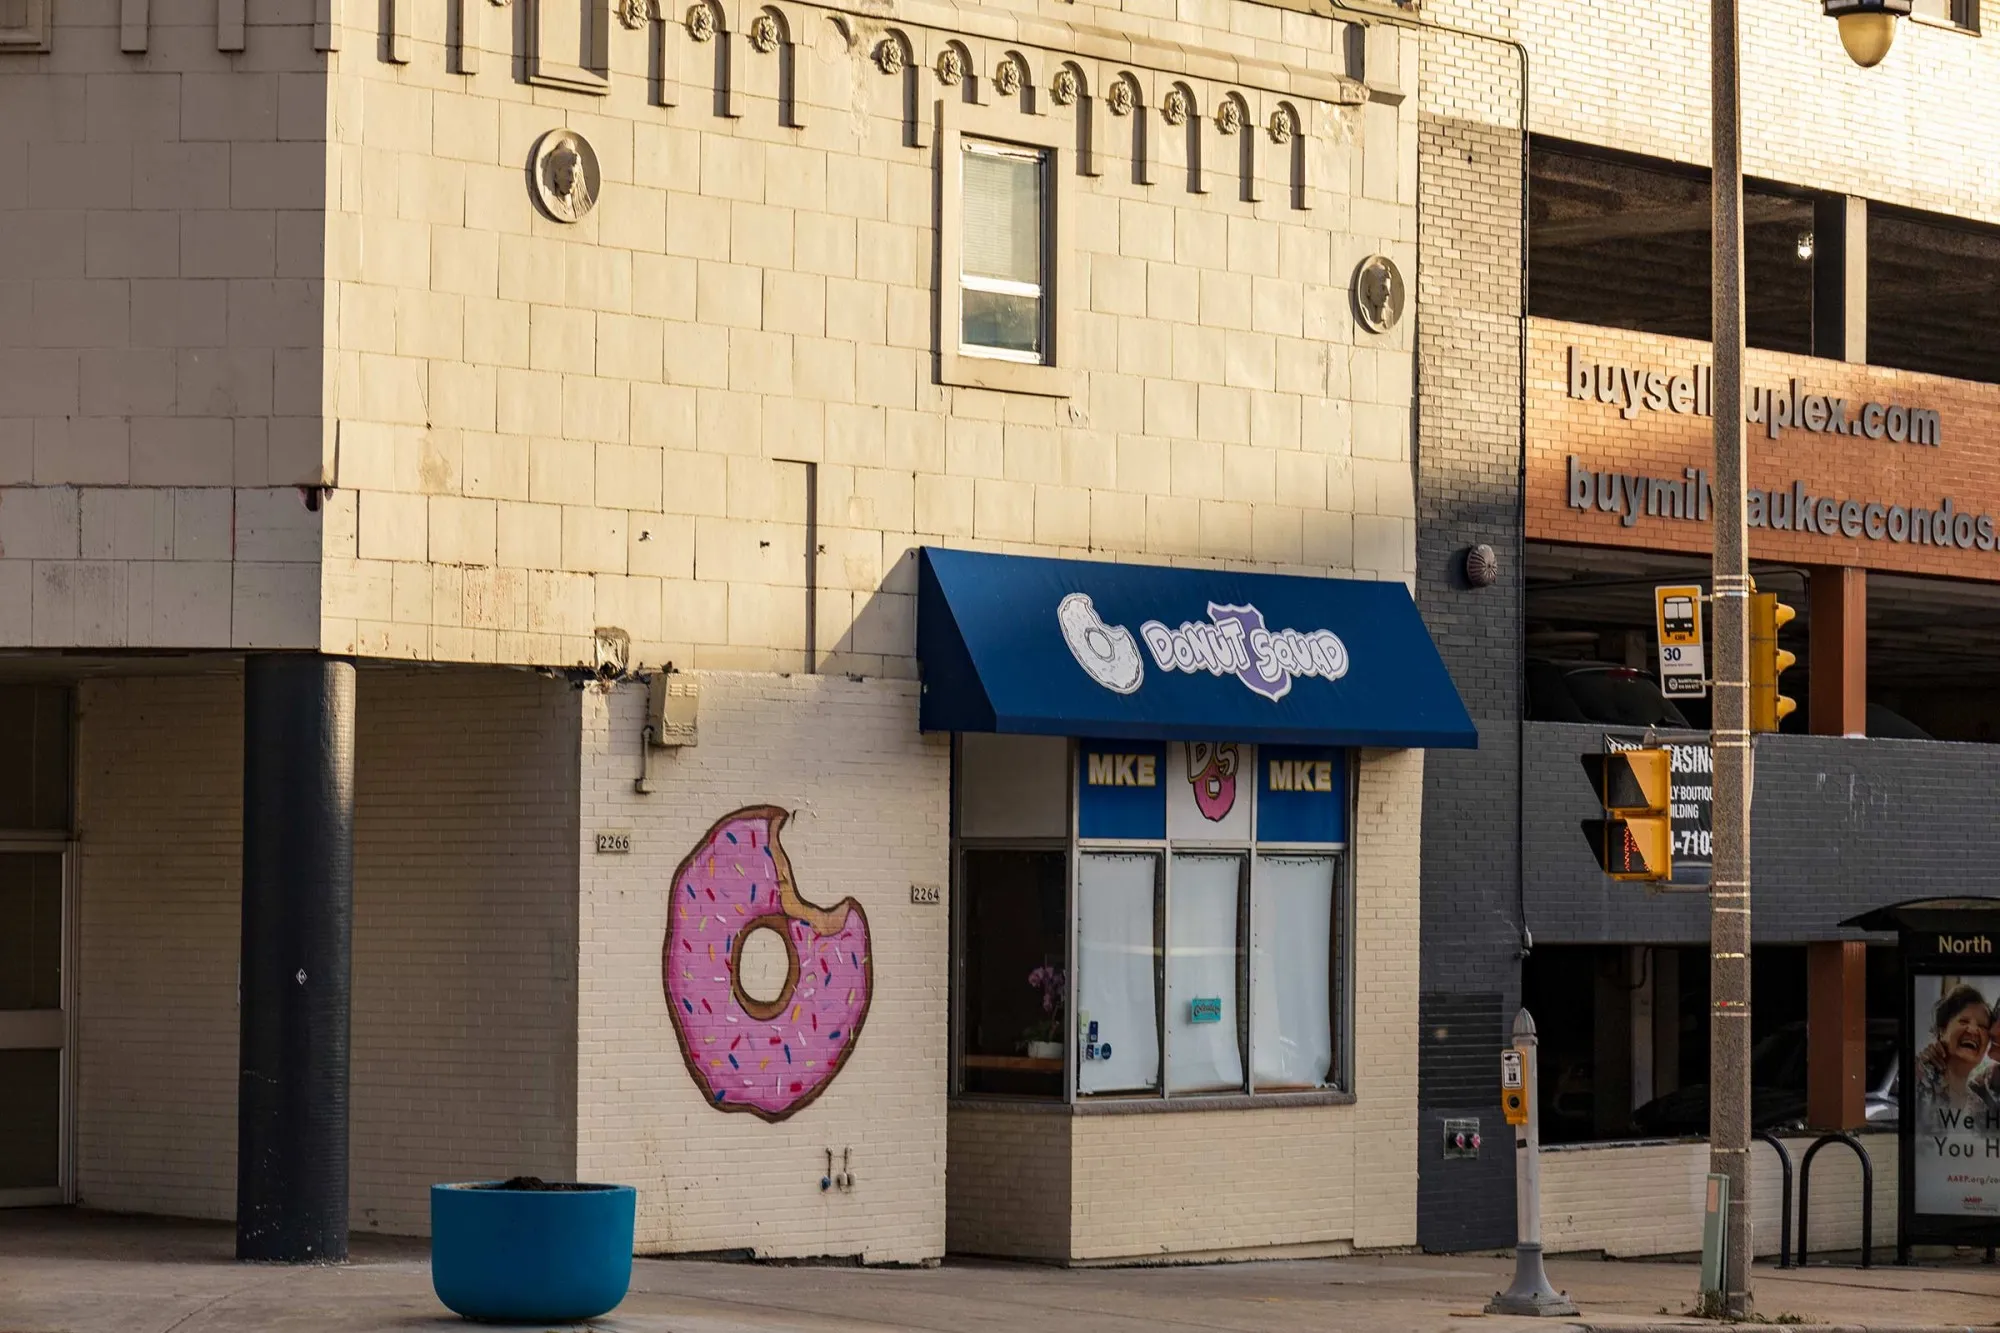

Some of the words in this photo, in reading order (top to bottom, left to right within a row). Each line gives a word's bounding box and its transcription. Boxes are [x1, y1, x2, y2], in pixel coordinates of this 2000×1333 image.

[1568, 345, 1941, 446] buyselluplex.com
[1141, 618, 1251, 675] DONUT
[1250, 626, 1349, 682] SQUAD
[1663, 647, 1681, 661] 30
[1088, 753, 1157, 787] MKE
[1269, 760, 1332, 792] MKE
[1681, 785, 1713, 802] BOUTIQU
[600, 835, 629, 849] 2266
[914, 887, 939, 901] 2264
[1938, 934, 1992, 954] North
[1939, 1108, 1974, 1129] We
[1934, 1136, 1974, 1158] You
